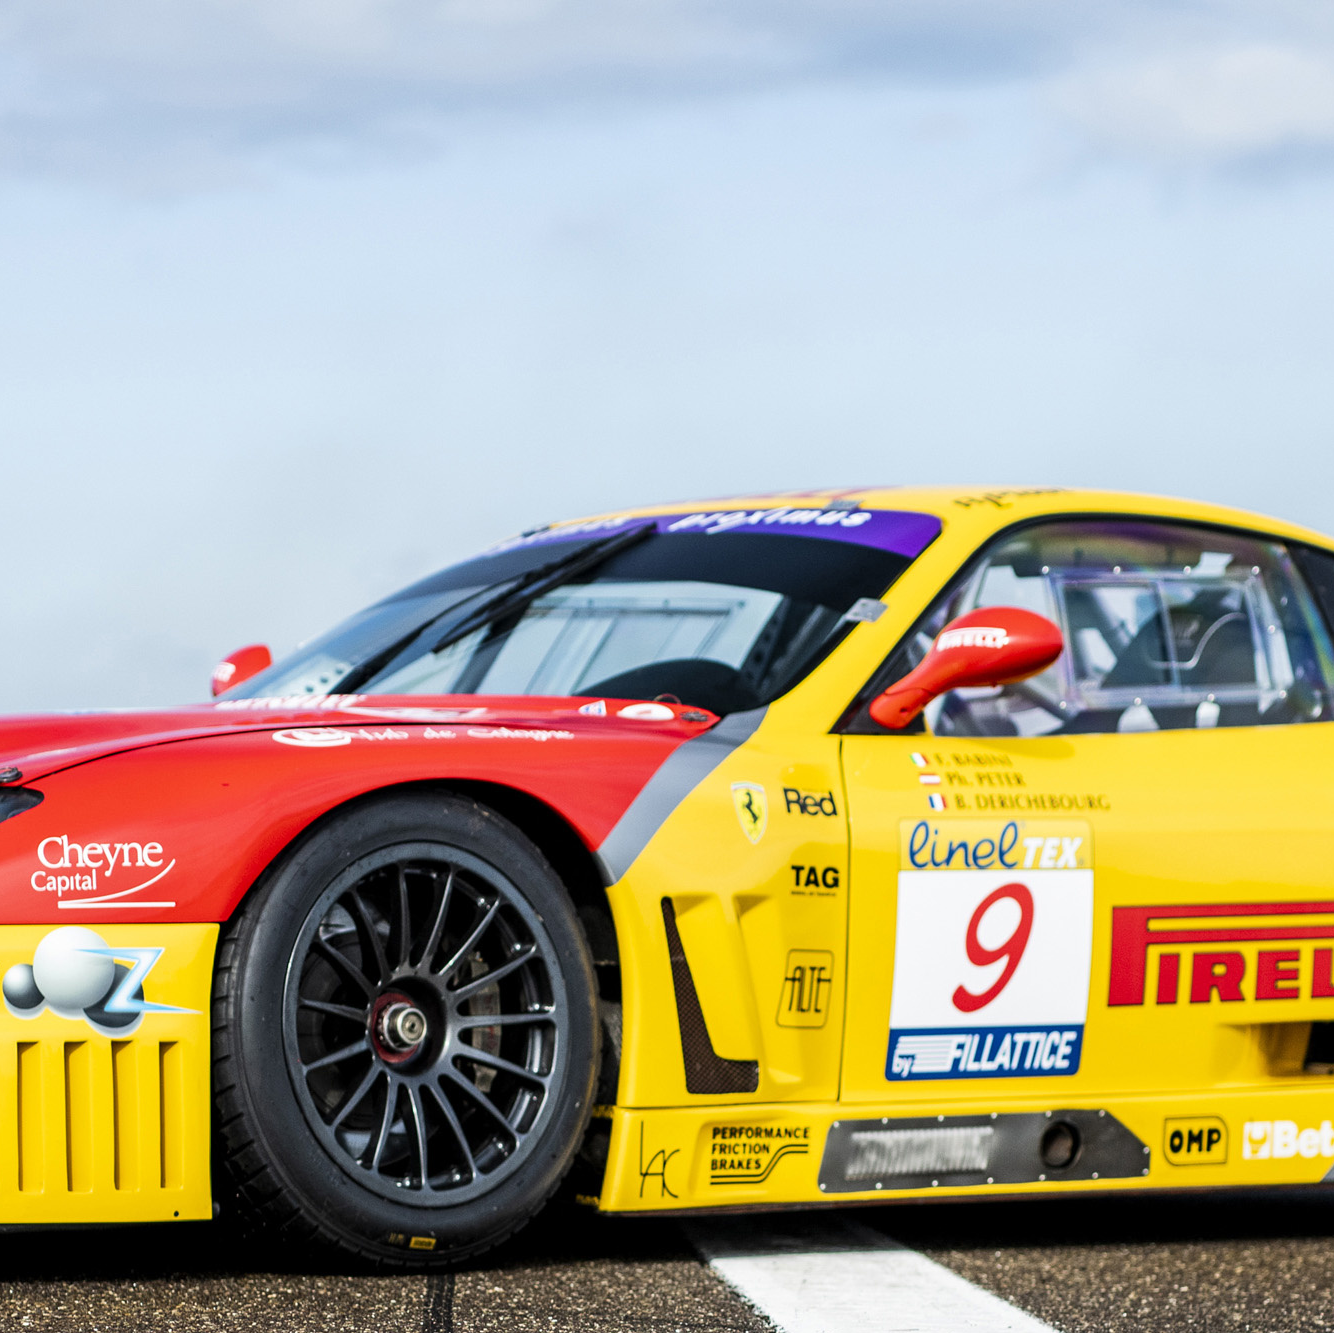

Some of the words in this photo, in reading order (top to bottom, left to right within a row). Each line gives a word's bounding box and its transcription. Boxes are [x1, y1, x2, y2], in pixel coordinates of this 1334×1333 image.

[975, 771, 1026, 787] PETER
[783, 787, 838, 816] Red
[36, 834, 164, 878] Cheyne
[909, 820, 1018, 869] linel
[30, 868, 98, 897] Capital
[791, 865, 840, 889] TAG
[952, 882, 1035, 1013] 9
[945, 1030, 1078, 1073] FILLATTICE
[712, 1126, 811, 1140] PERFORMANCE
[1169, 1127, 1222, 1153] OMP
[711, 1142, 771, 1155] FRICTION
[710, 1158, 763, 1171] BRAKES
